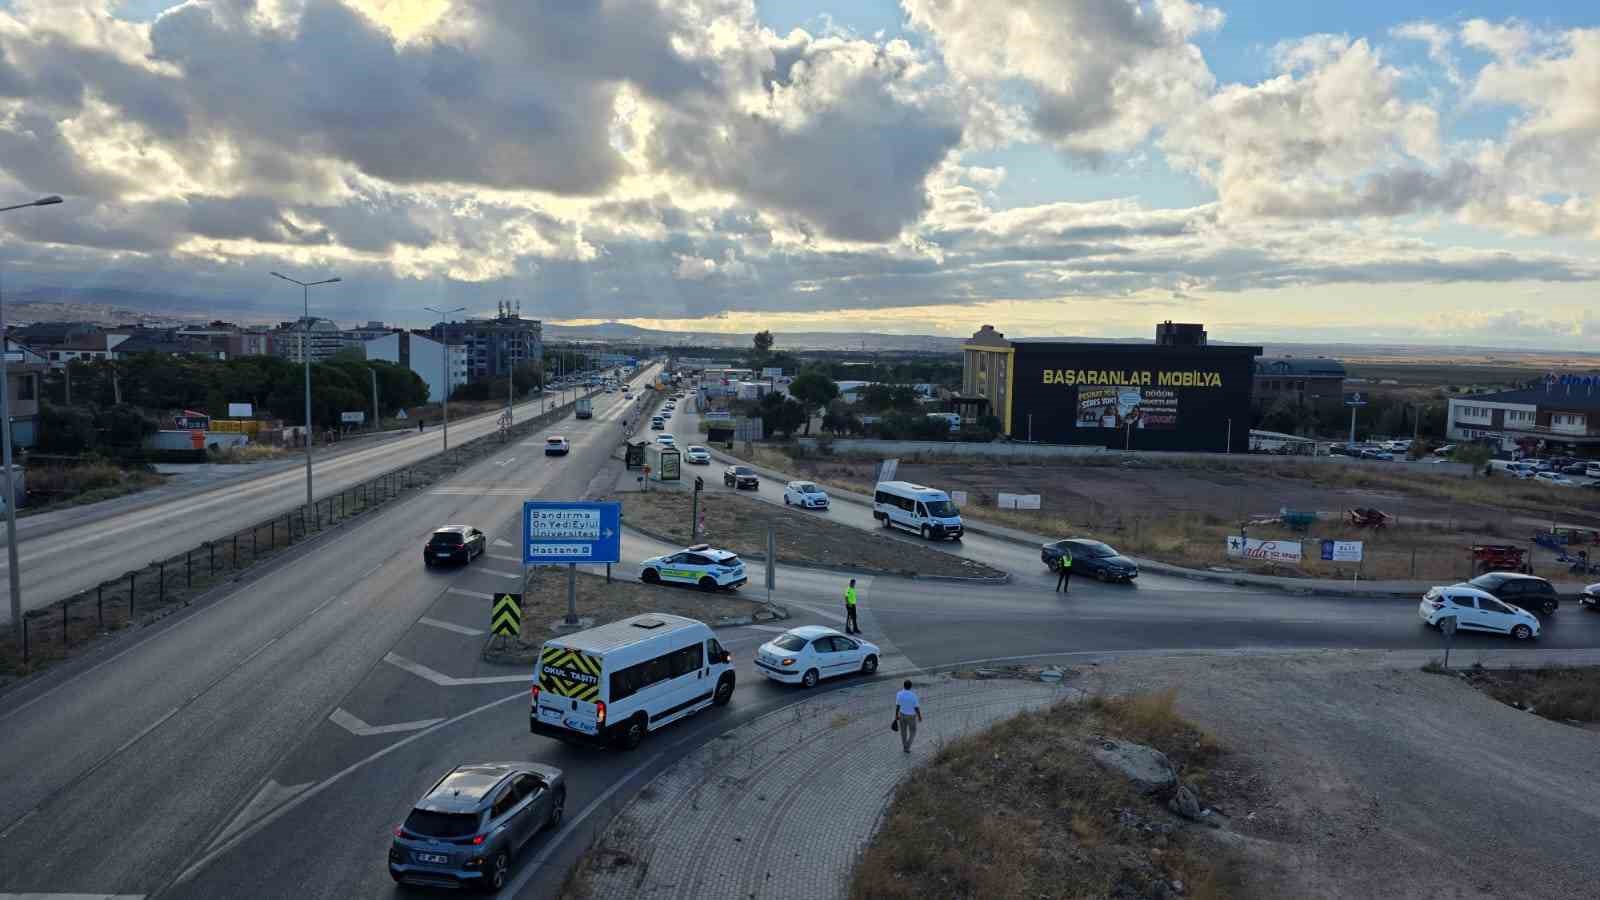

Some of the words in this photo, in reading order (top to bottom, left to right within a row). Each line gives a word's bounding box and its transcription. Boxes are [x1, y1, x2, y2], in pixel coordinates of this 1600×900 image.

[1043, 369, 1152, 386] BAŞARANLAR
[1158, 369, 1222, 386] MOBİLYA
[544, 666, 567, 677] OKUL
